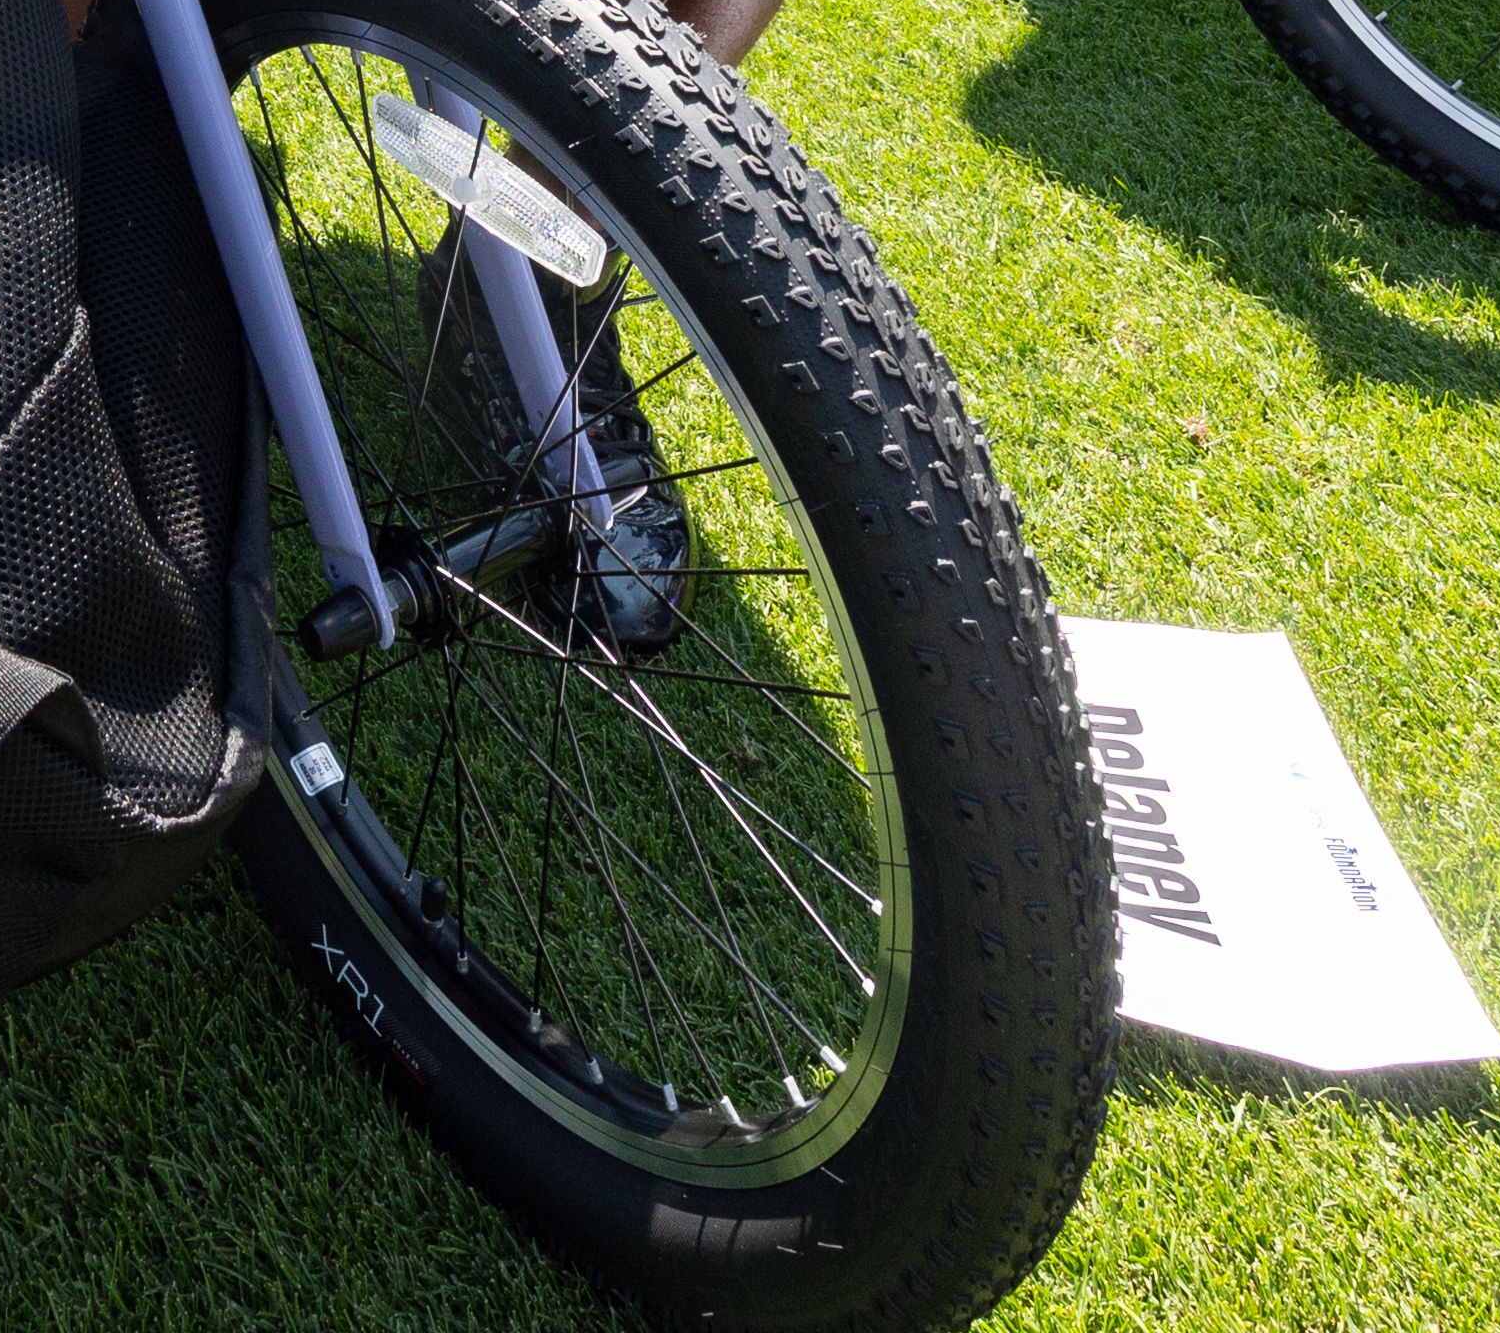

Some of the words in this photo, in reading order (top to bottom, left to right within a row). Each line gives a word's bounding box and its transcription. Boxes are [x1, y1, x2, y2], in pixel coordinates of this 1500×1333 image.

[1080, 703, 1222, 947] Delaney
[1321, 837, 1379, 912] FOUNDATION
[311, 923, 384, 1037] XR1
